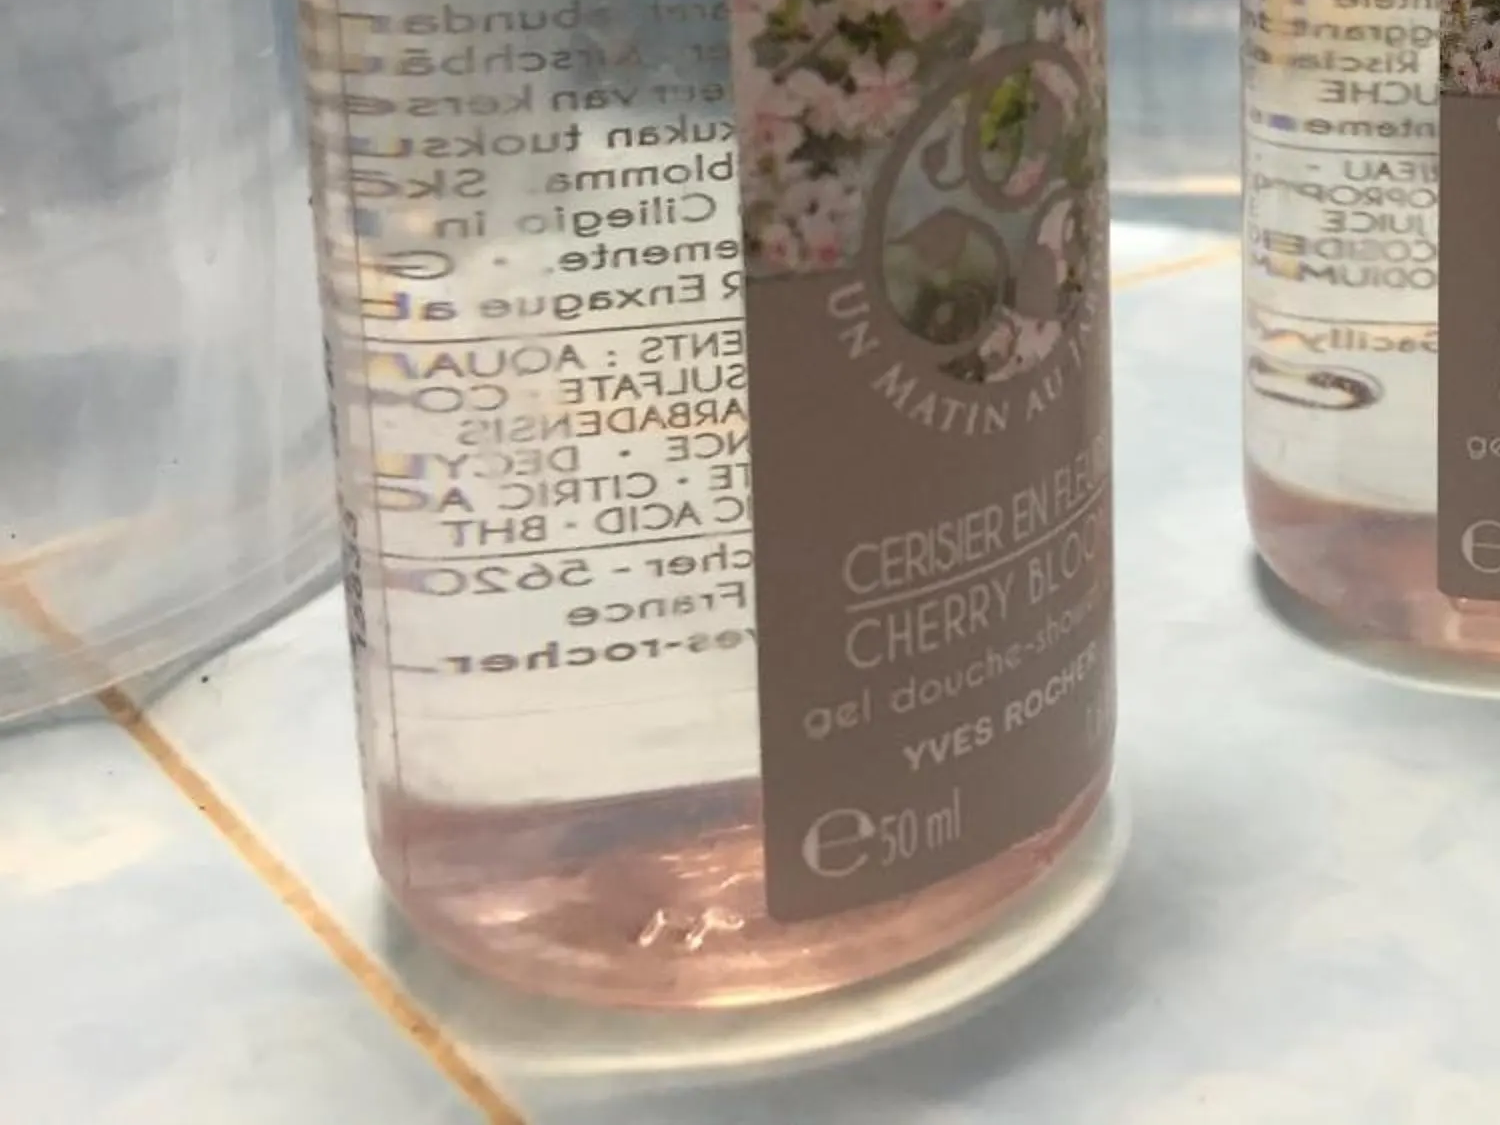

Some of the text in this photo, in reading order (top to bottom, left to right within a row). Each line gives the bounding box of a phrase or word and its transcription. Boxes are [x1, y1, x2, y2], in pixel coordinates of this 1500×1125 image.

[827, 280, 881, 360] UN
[870, 360, 1010, 437] MATIN
[844, 505, 1004, 595] CERISIER
[1012, 478, 1048, 543] EN
[845, 567, 1016, 670] CHERRY
[803, 689, 871, 740] gel
[903, 716, 993, 772] YVES
[1004, 641, 1098, 732] ROCHER
[879, 806, 918, 867] 50
[927, 786, 961, 848] ml
